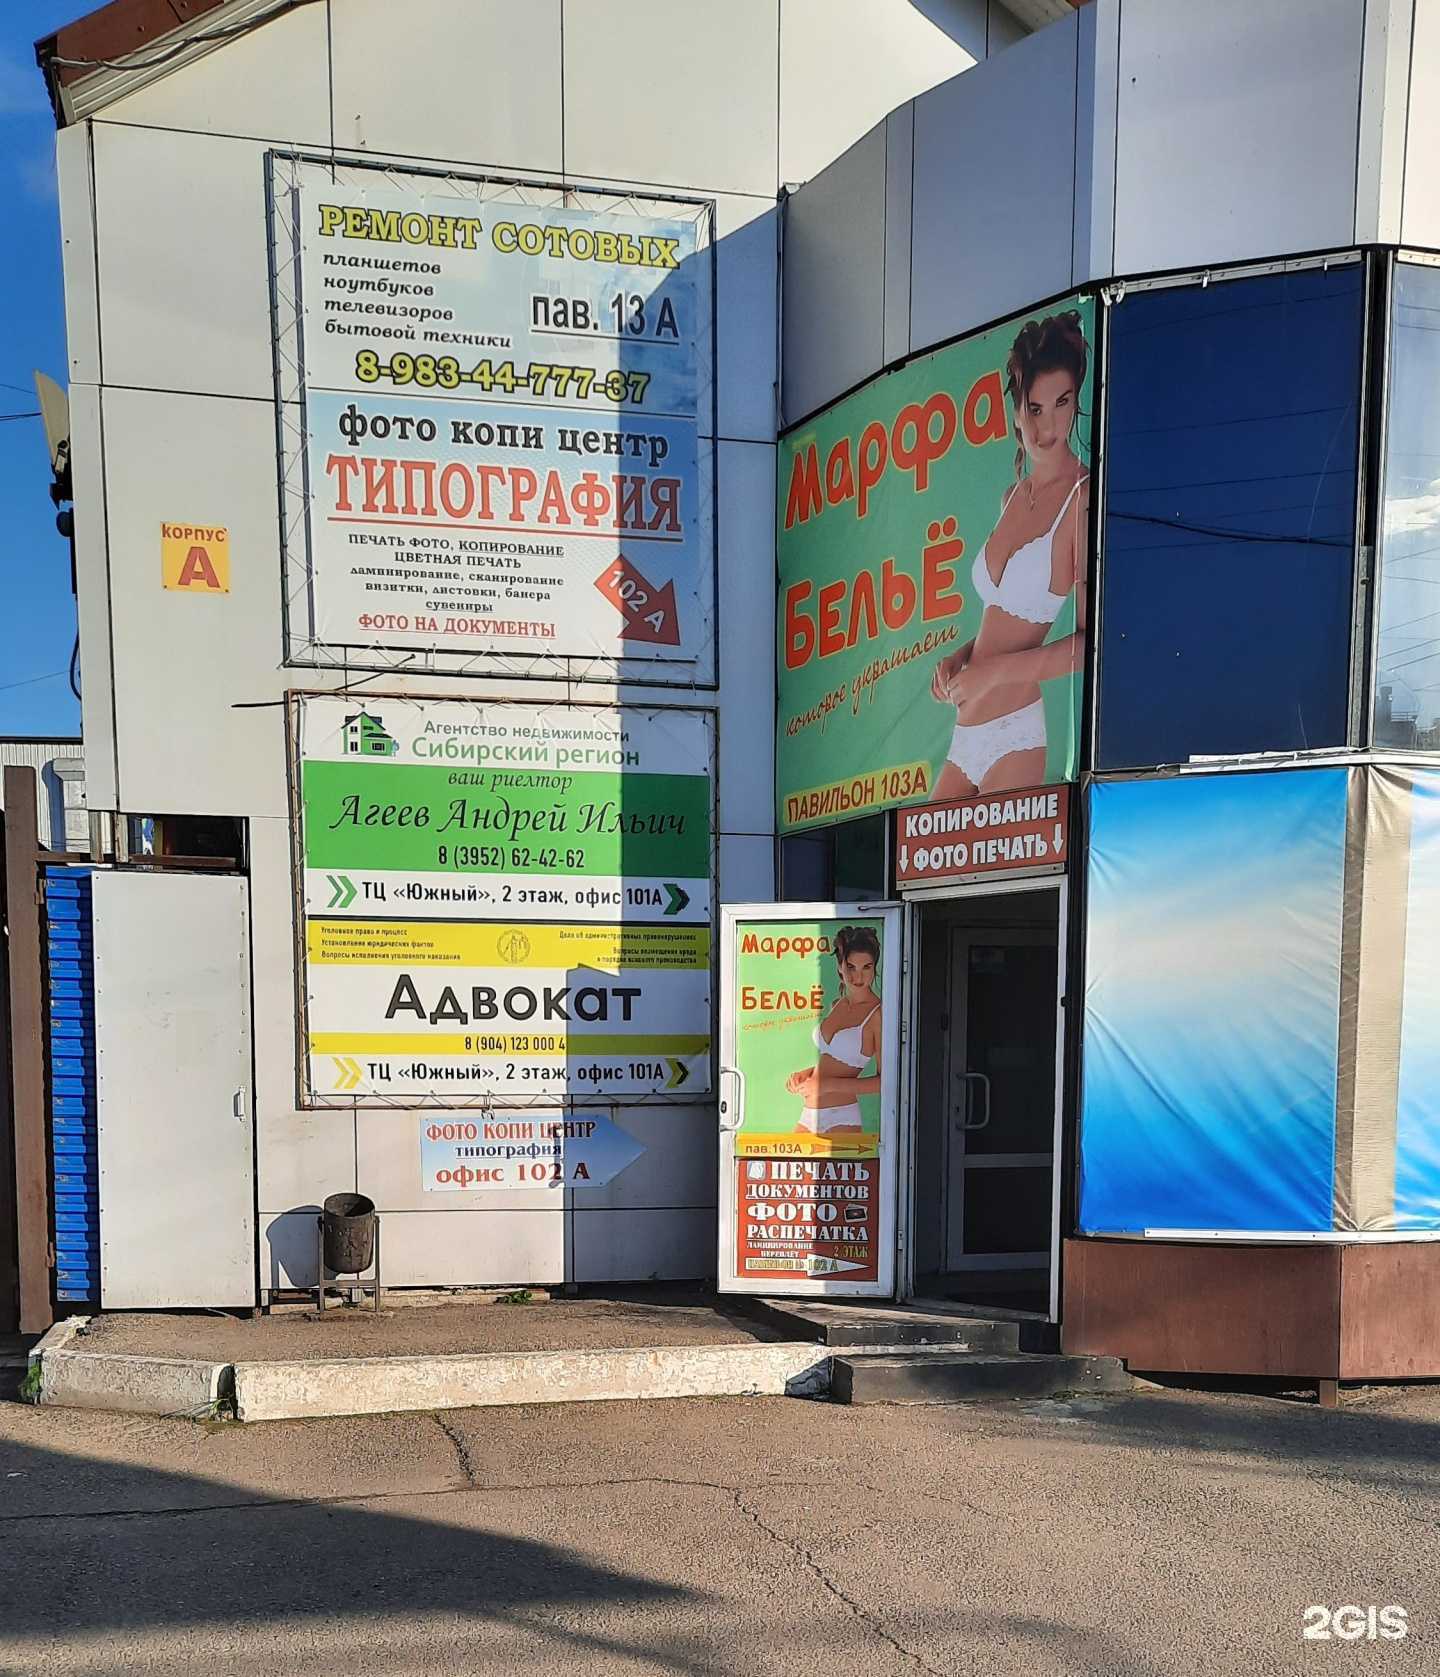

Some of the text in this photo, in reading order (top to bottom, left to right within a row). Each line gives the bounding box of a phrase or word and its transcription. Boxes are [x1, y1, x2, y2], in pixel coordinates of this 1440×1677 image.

[319, 204, 680, 269] РЕМОНТ СОТОВЫХ
[323, 254, 441, 275] планшетов
[324, 276, 434, 297] ноутбуков
[324, 299, 453, 322] телевизоров
[532, 293, 679, 338] пав. 13 А
[325, 319, 511, 348] бытовой техники
[355, 349, 650, 404] 8-983-44-777-37
[338, 403, 669, 467] фото копи центр
[783, 367, 1009, 532] Марфа
[326, 453, 682, 532] ТИПОГРАФИЯ
[348, 533, 565, 556] ПЕЧАТЬ ФОТО, КОПИРОВАНИЕ
[178, 546, 221, 588] А
[394, 551, 521, 569] ЦВЕТНАЯ ПЕЧАТЬ
[468, 571, 565, 587] сканирование
[365, 582, 551, 602] визитки, листовки, банера
[608, 570, 665, 633] 102 А
[783, 515, 966, 670] БЕЛЬЁ
[425, 600, 493, 613] сувениры
[358, 613, 556, 637] ФОТО НА ДОКУМЕНТЫ
[851, 624, 959, 716] украшает
[424, 720, 629, 742] Агентство недвижимости
[412, 737, 640, 768] Сибирский регион
[448, 771, 573, 795] ваш риелтор
[788, 766, 928, 823] ПАВИЛЬОН 103А
[329, 794, 686, 841] Агеев Андрей Ильич
[905, 793, 1059, 838] КОПИРОВАНИЕ
[438, 845, 585, 870] 8 (3952) 62-42-62
[913, 833, 1048, 872] ФОТО ПЕЧАТЬ
[362, 881, 386, 902] ТЦ
[502, 885, 512, 902] 2
[518, 888, 569, 905] этаж,
[575, 888, 621, 908] офис
[627, 888, 663, 905] 101А
[741, 934, 831, 959] Марфа
[384, 973, 642, 1026] Адвокат
[465, 1036, 566, 1053] 8 (904) 123 000 4
[367, 1063, 391, 1081] ТЦ
[506, 1063, 515, 1080] 2
[521, 1065, 571, 1082] этаж,
[577, 1064, 623, 1085] офис
[628, 1064, 664, 1080] 101А
[426, 1121, 596, 1141] ФОТО КОПИ ЦЕНТР
[456, 1142, 562, 1159] типография
[435, 1162, 590, 1187] офис 102 А
[770, 1161, 870, 1181] ПЕЧАТЬ
[745, 1184, 869, 1199] ДОКУМЕНТОВ
[747, 1202, 838, 1222] ФОТО
[746, 1225, 869, 1241] РАСПЕЧАТКА
